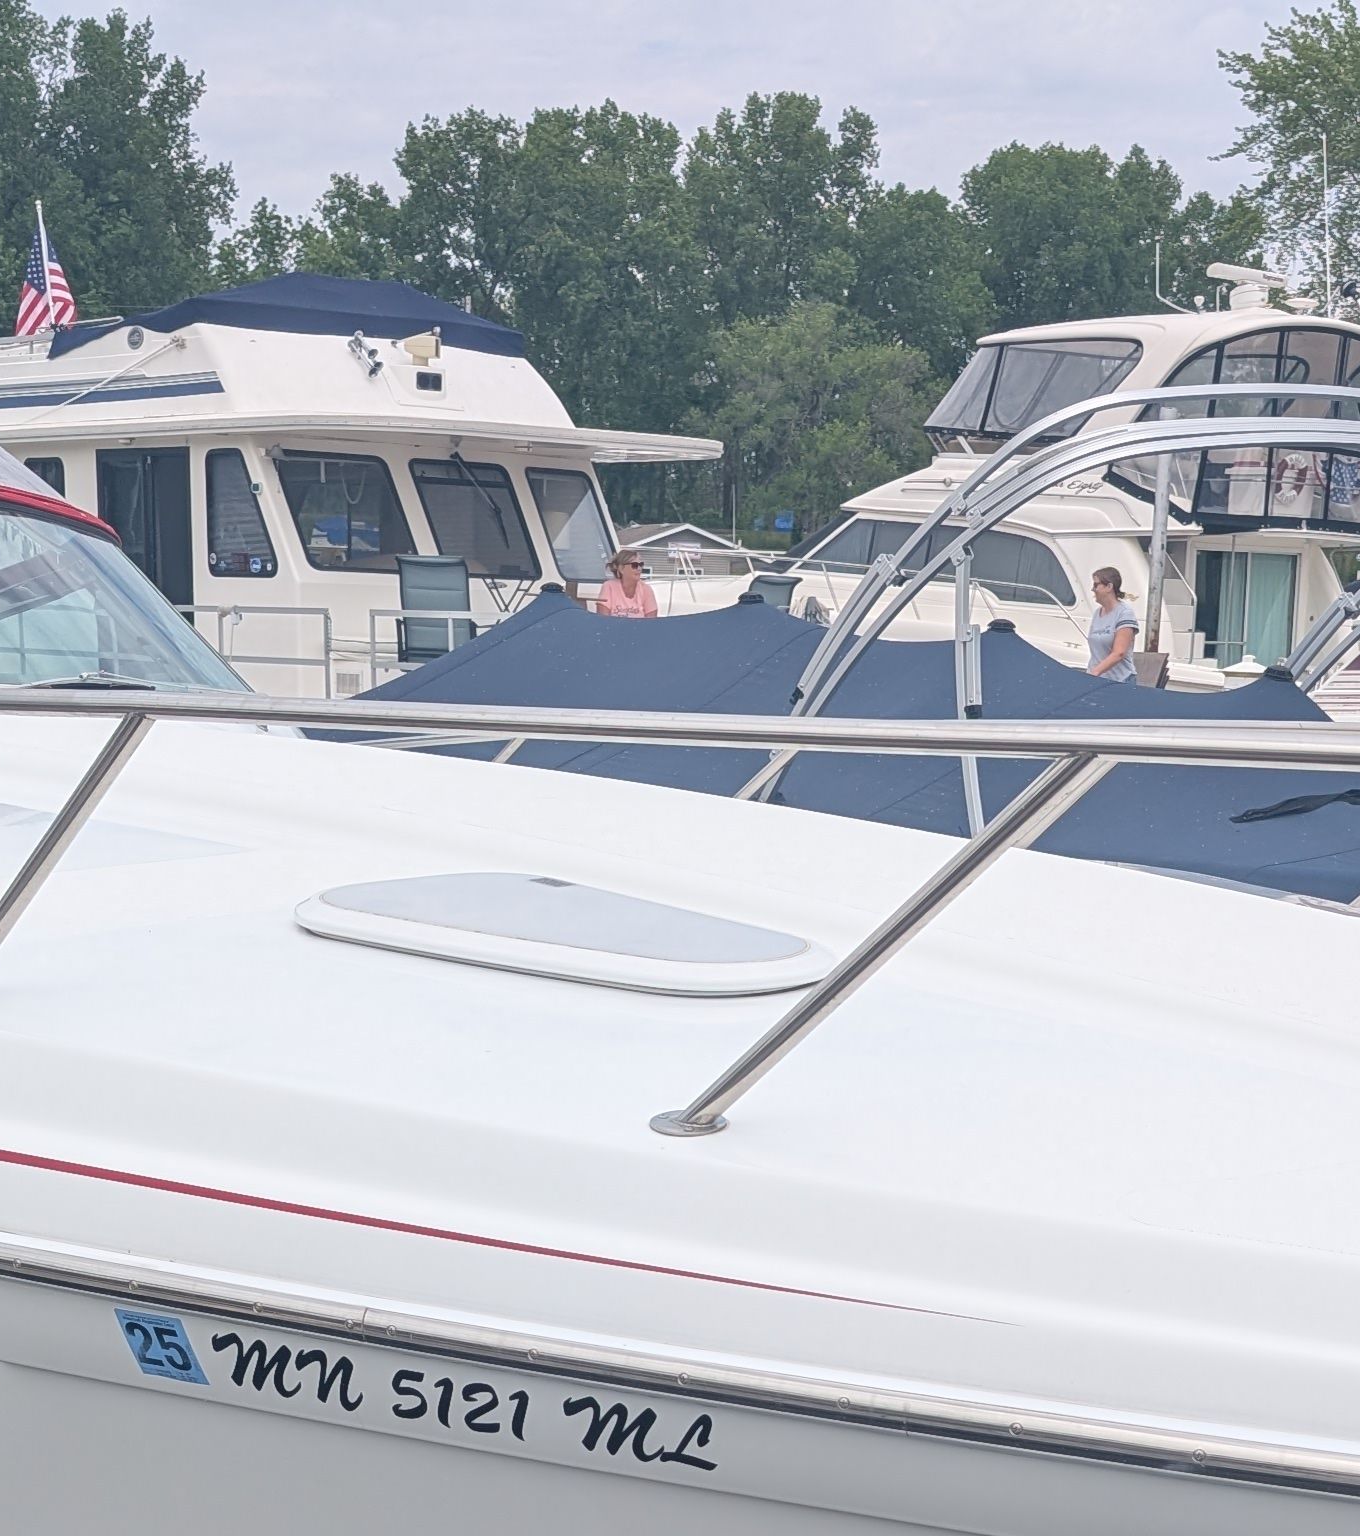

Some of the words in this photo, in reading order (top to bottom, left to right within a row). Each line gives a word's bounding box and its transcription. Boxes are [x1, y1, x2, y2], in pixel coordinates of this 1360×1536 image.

[125, 1322, 192, 1371] 25
[212, 1332, 364, 1411] MN
[391, 1370, 528, 1441] 5121
[563, 1396, 718, 1472] ML
